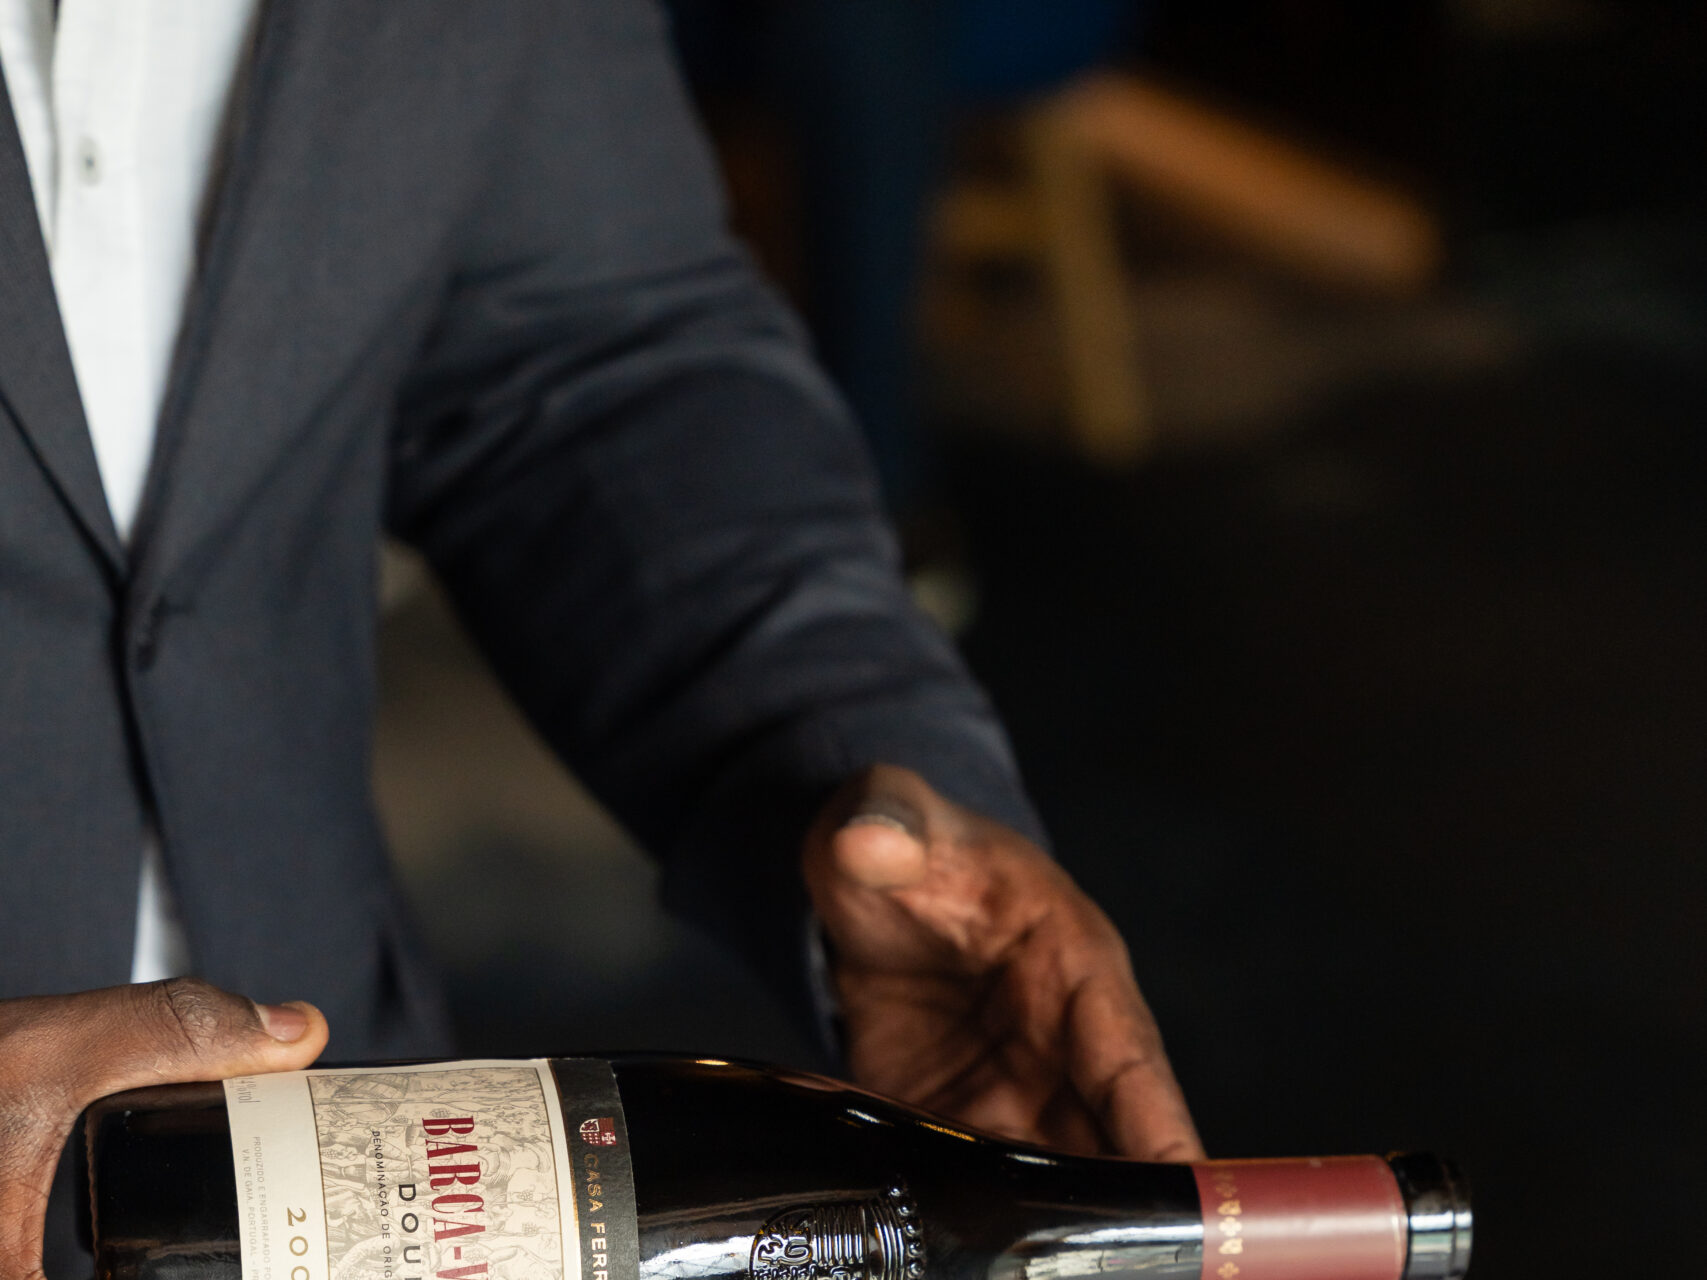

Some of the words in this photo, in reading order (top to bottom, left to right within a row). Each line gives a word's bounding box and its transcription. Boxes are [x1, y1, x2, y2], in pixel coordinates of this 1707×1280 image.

[243, 1166, 252, 1178] DE
[253, 1136, 265, 1183] PRODUZIDO
[372, 1130, 391, 1217] DENOMINAÇÃO
[583, 1153, 603, 1212] CASA
[247, 1206, 259, 1256] PORTUGAL
[258, 1194, 271, 1263] ENGARRAFADO
[381, 1223, 393, 1239] DE
